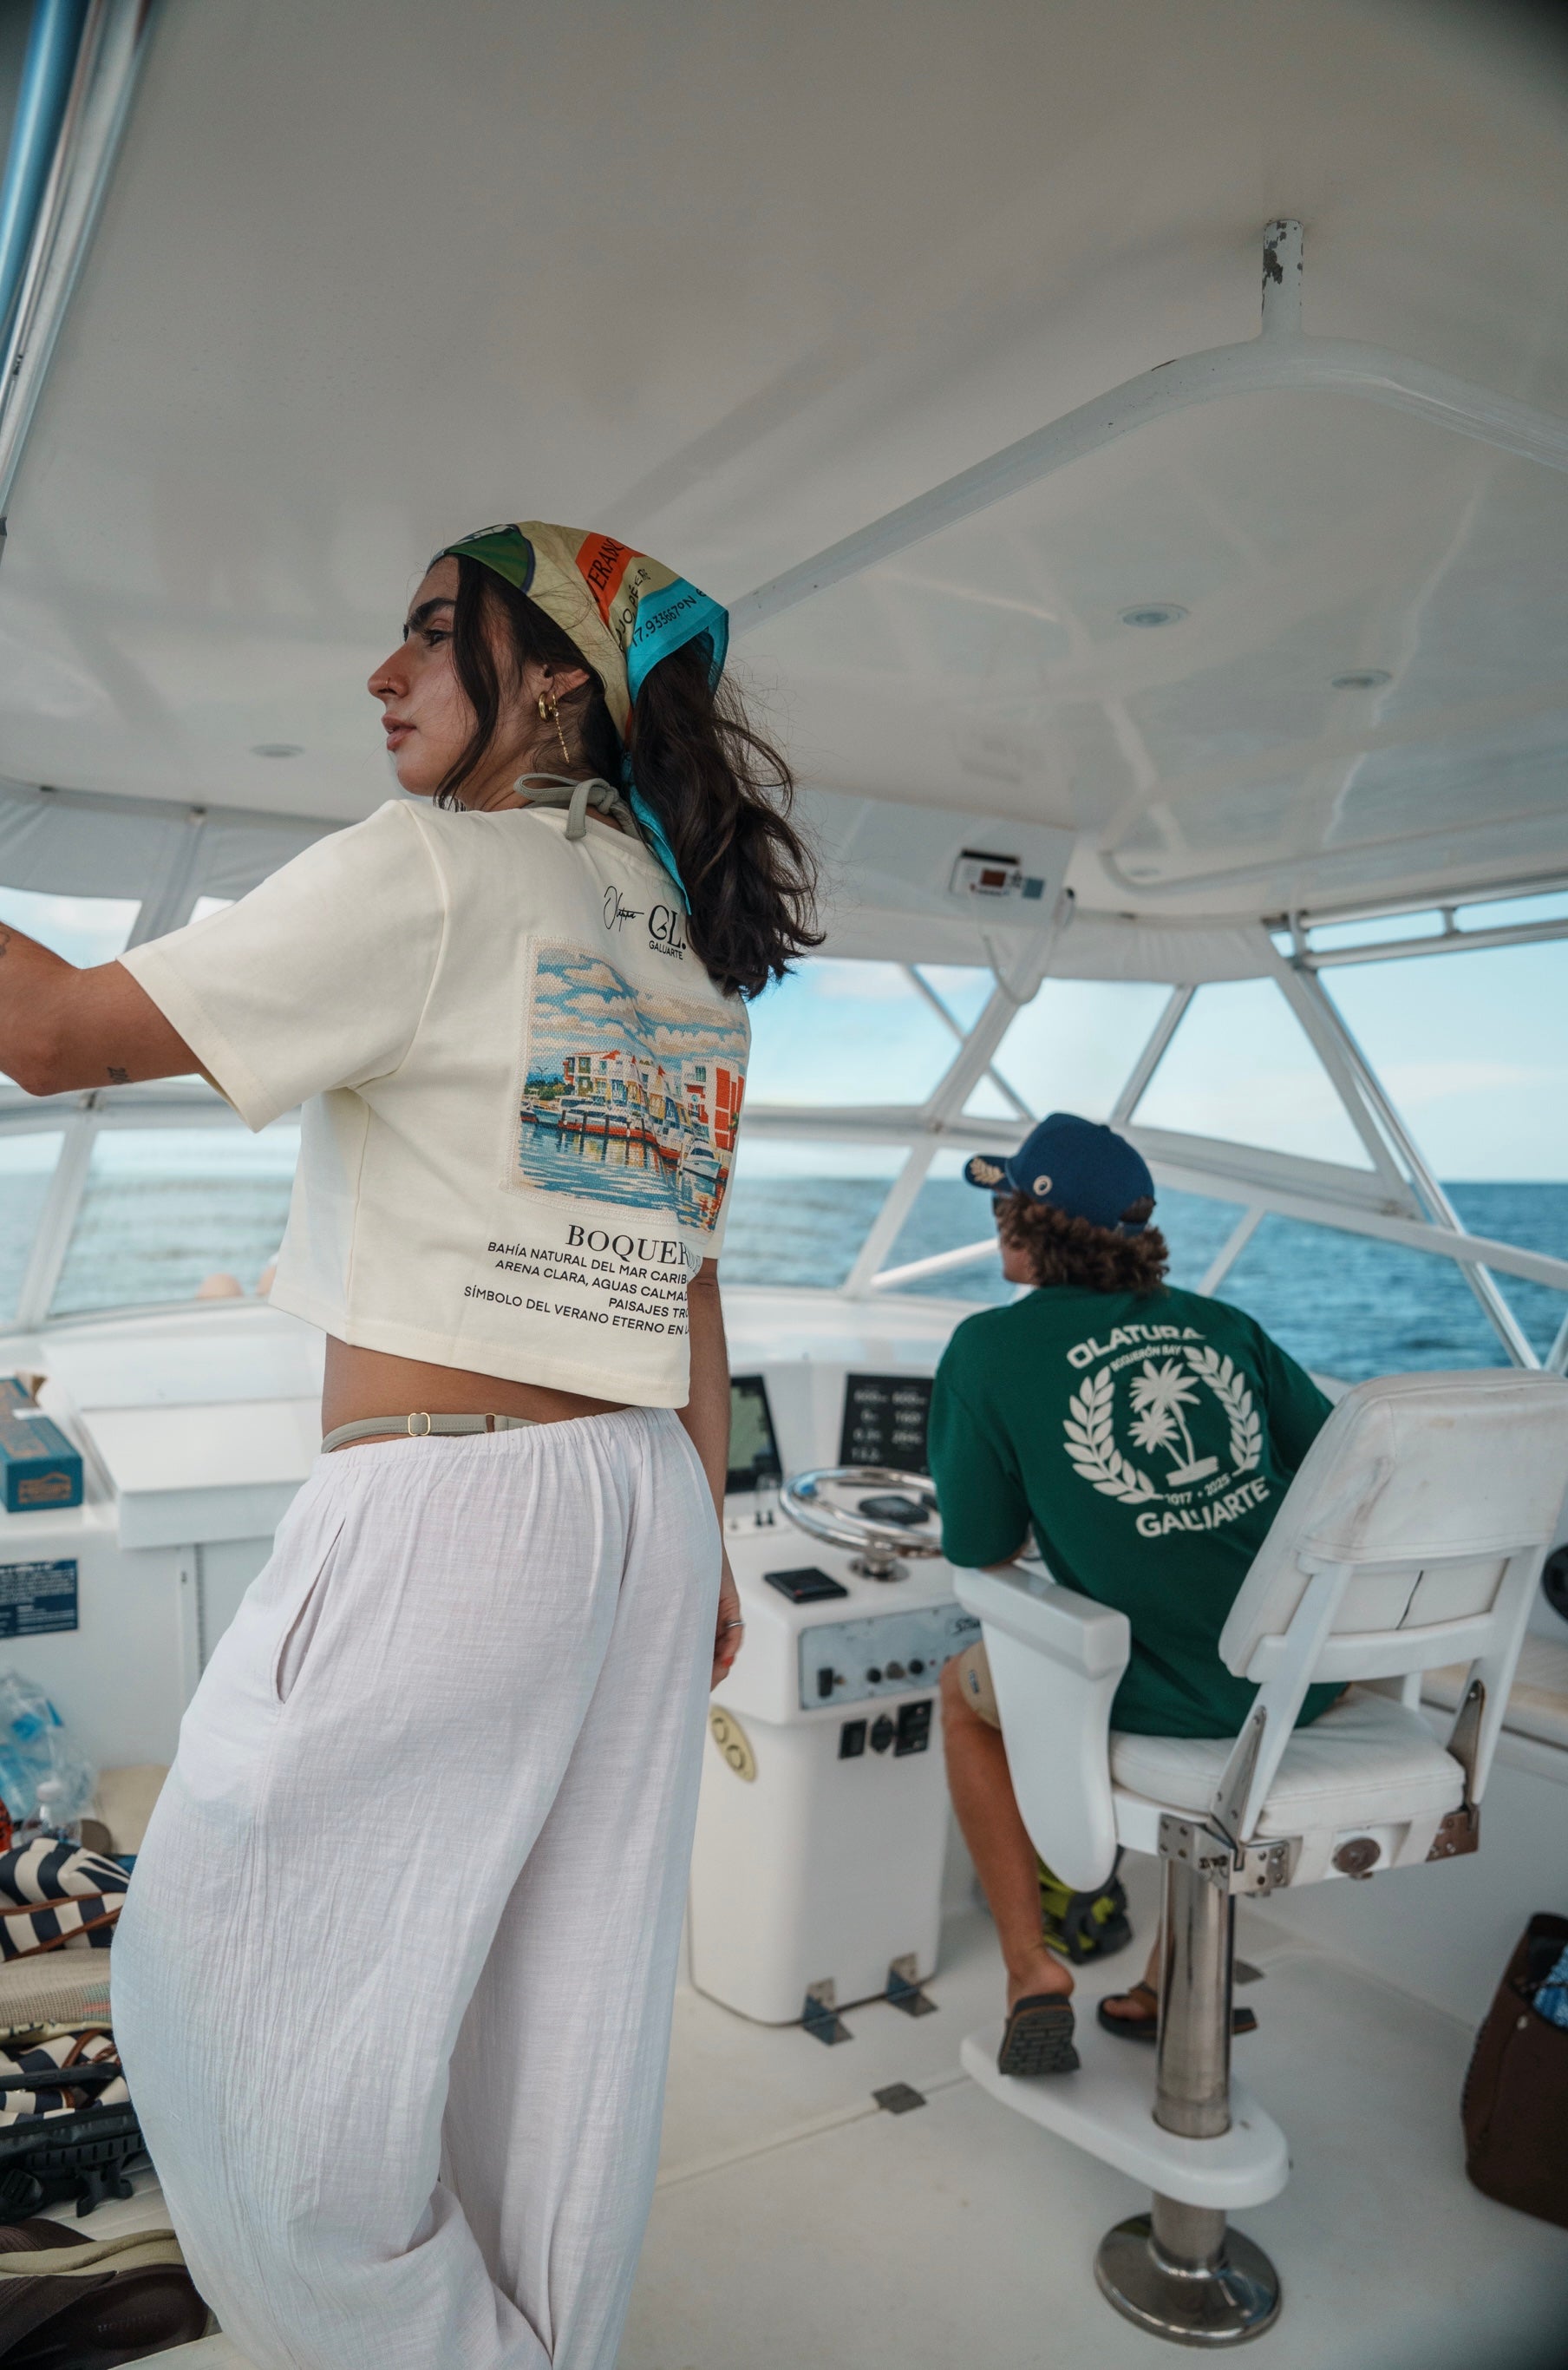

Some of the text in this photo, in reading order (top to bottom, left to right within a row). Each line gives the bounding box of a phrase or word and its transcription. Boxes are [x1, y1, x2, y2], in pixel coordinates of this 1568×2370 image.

[487, 1241, 688, 1285] BAHÍA NATURAL DEL MAR CARIB
[495, 1260, 539, 1276] ARENA
[543, 1267, 589, 1287] CLARA,
[591, 1277, 637, 1294] AGUAS
[464, 1285, 522, 1306] SÍMBOLO
[526, 1299, 551, 1313] DEL
[554, 1304, 609, 1324] VERANO
[612, 1315, 664, 1333] ETERNO
[668, 1324, 683, 1335] EN
[609, 1298, 669, 1317] PAISAJES
[1067, 1324, 1206, 1369] OLATURA
[1162, 1344, 1181, 1355] BAY
